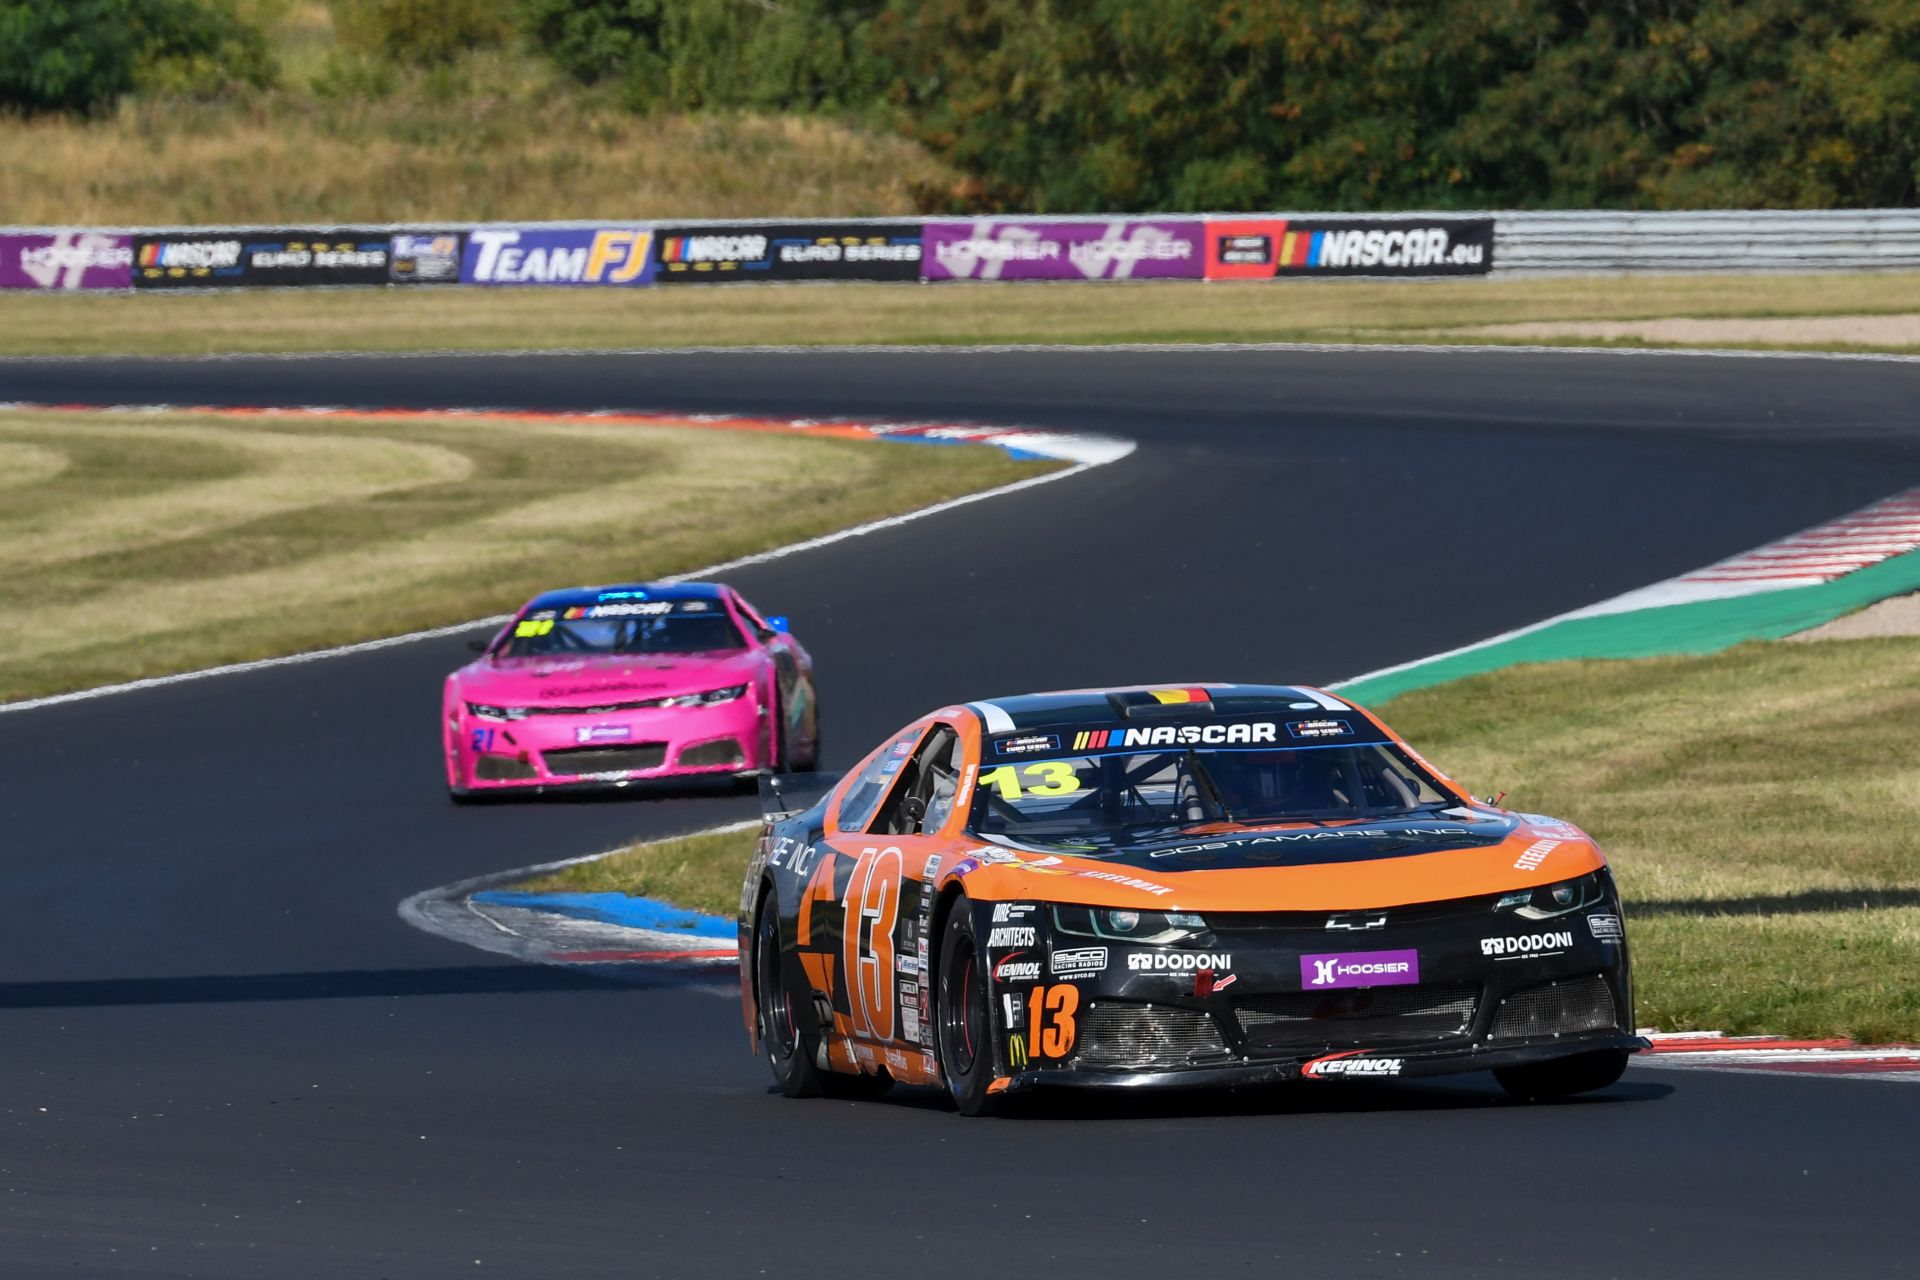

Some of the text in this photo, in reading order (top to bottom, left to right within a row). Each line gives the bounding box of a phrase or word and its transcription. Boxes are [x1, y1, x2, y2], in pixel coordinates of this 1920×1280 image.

[780, 244, 922, 262] EURO SERIES
[1320, 228, 1483, 267] NASCAR.eu
[472, 728, 494, 751] 21
[1124, 723, 1276, 747] NASCAR
[979, 761, 1081, 800] 13
[1150, 829, 1388, 858] COSTAMARE
[841, 846, 903, 1044] 13
[987, 927, 1036, 947] ARCHITECTS
[1506, 932, 1573, 953] DODONI
[997, 963, 1040, 977] KENNOL
[1054, 960, 1104, 970] RACING RADIOS
[1154, 954, 1231, 969] DODONI
[1337, 962, 1409, 975] HOOSIER
[1028, 984, 1079, 1058] 13
[1309, 1058, 1402, 1073] KENNOL
